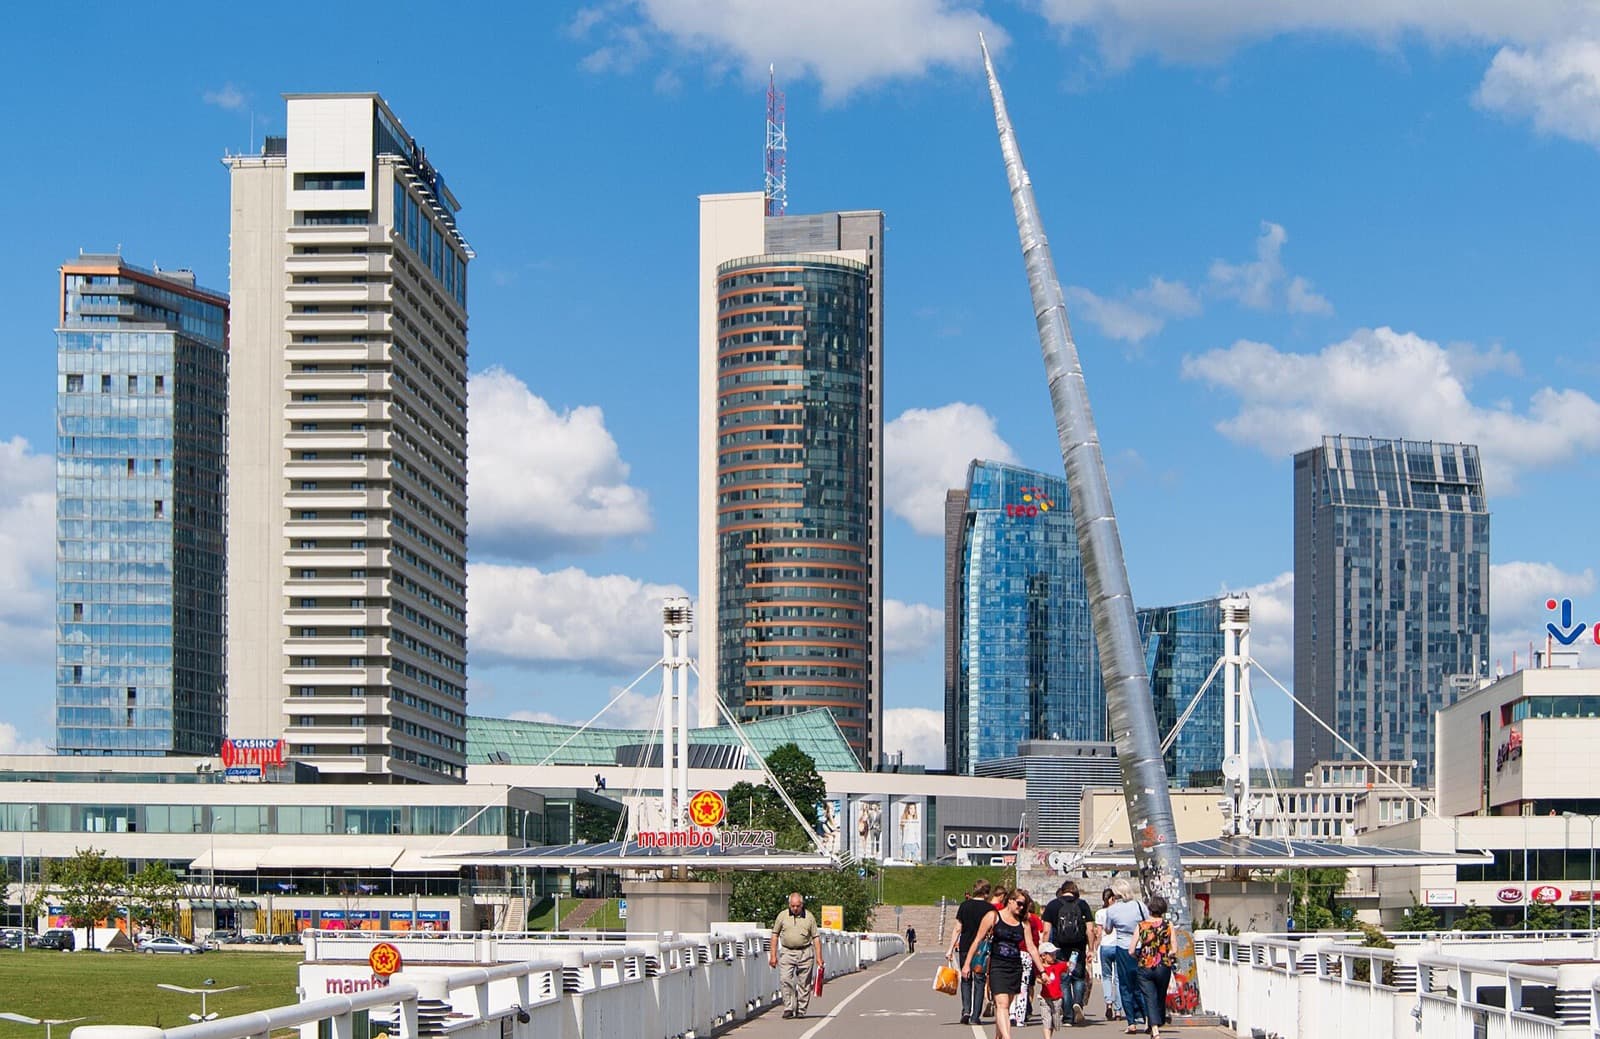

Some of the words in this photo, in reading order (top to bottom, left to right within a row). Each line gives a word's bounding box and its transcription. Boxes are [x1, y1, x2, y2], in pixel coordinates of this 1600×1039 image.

[235, 740, 274, 748] CASINO
[638, 826, 714, 848] mambo
[720, 825, 775, 852] pizza
[326, 974, 389, 994] mamb
